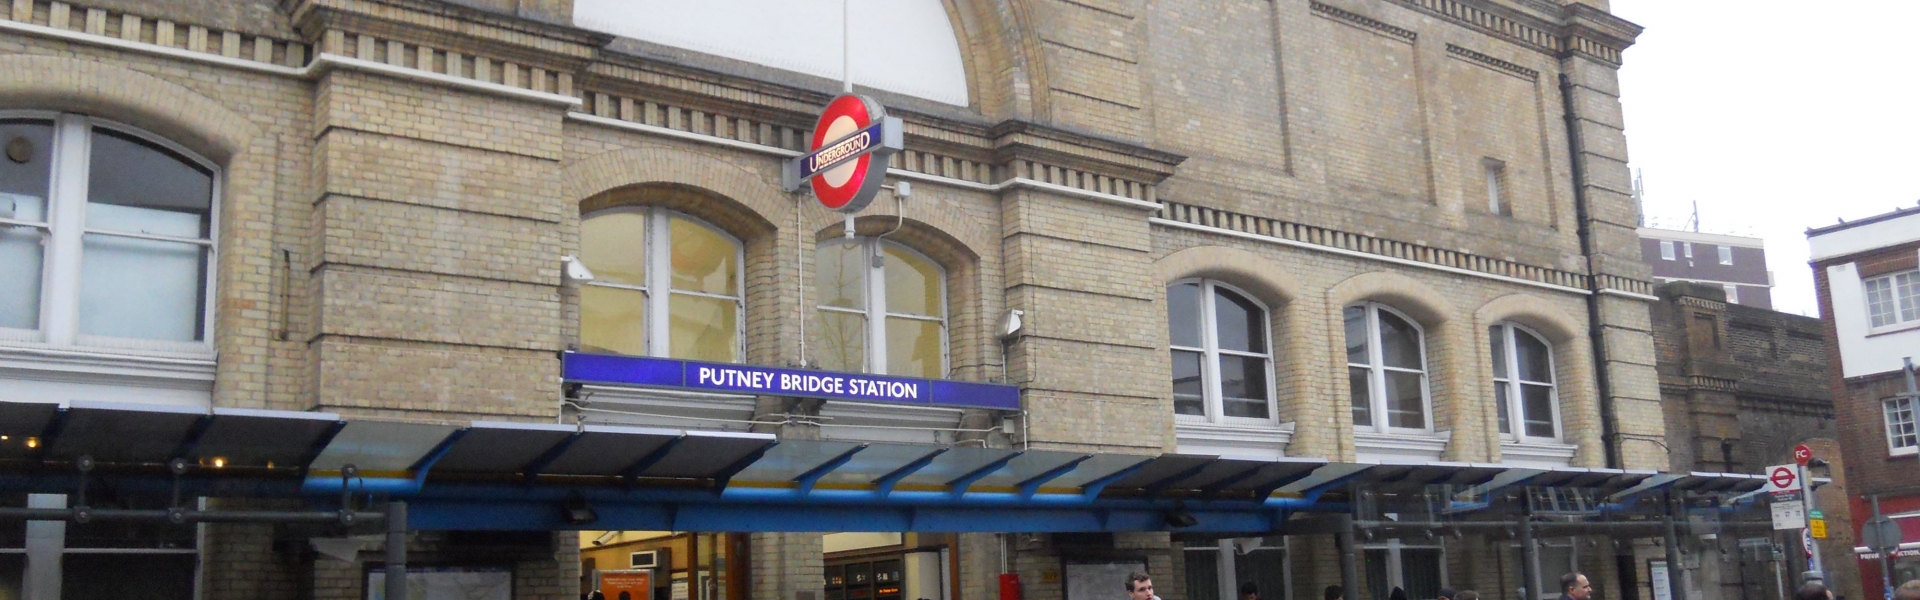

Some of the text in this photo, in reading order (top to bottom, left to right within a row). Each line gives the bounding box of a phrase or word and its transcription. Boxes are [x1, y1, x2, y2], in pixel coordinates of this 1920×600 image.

[809, 131, 871, 173] UNDERGROUND
[699, 366, 918, 399] PUTNEY BRIDGE STATION
[1795, 449, 1808, 459] FC
